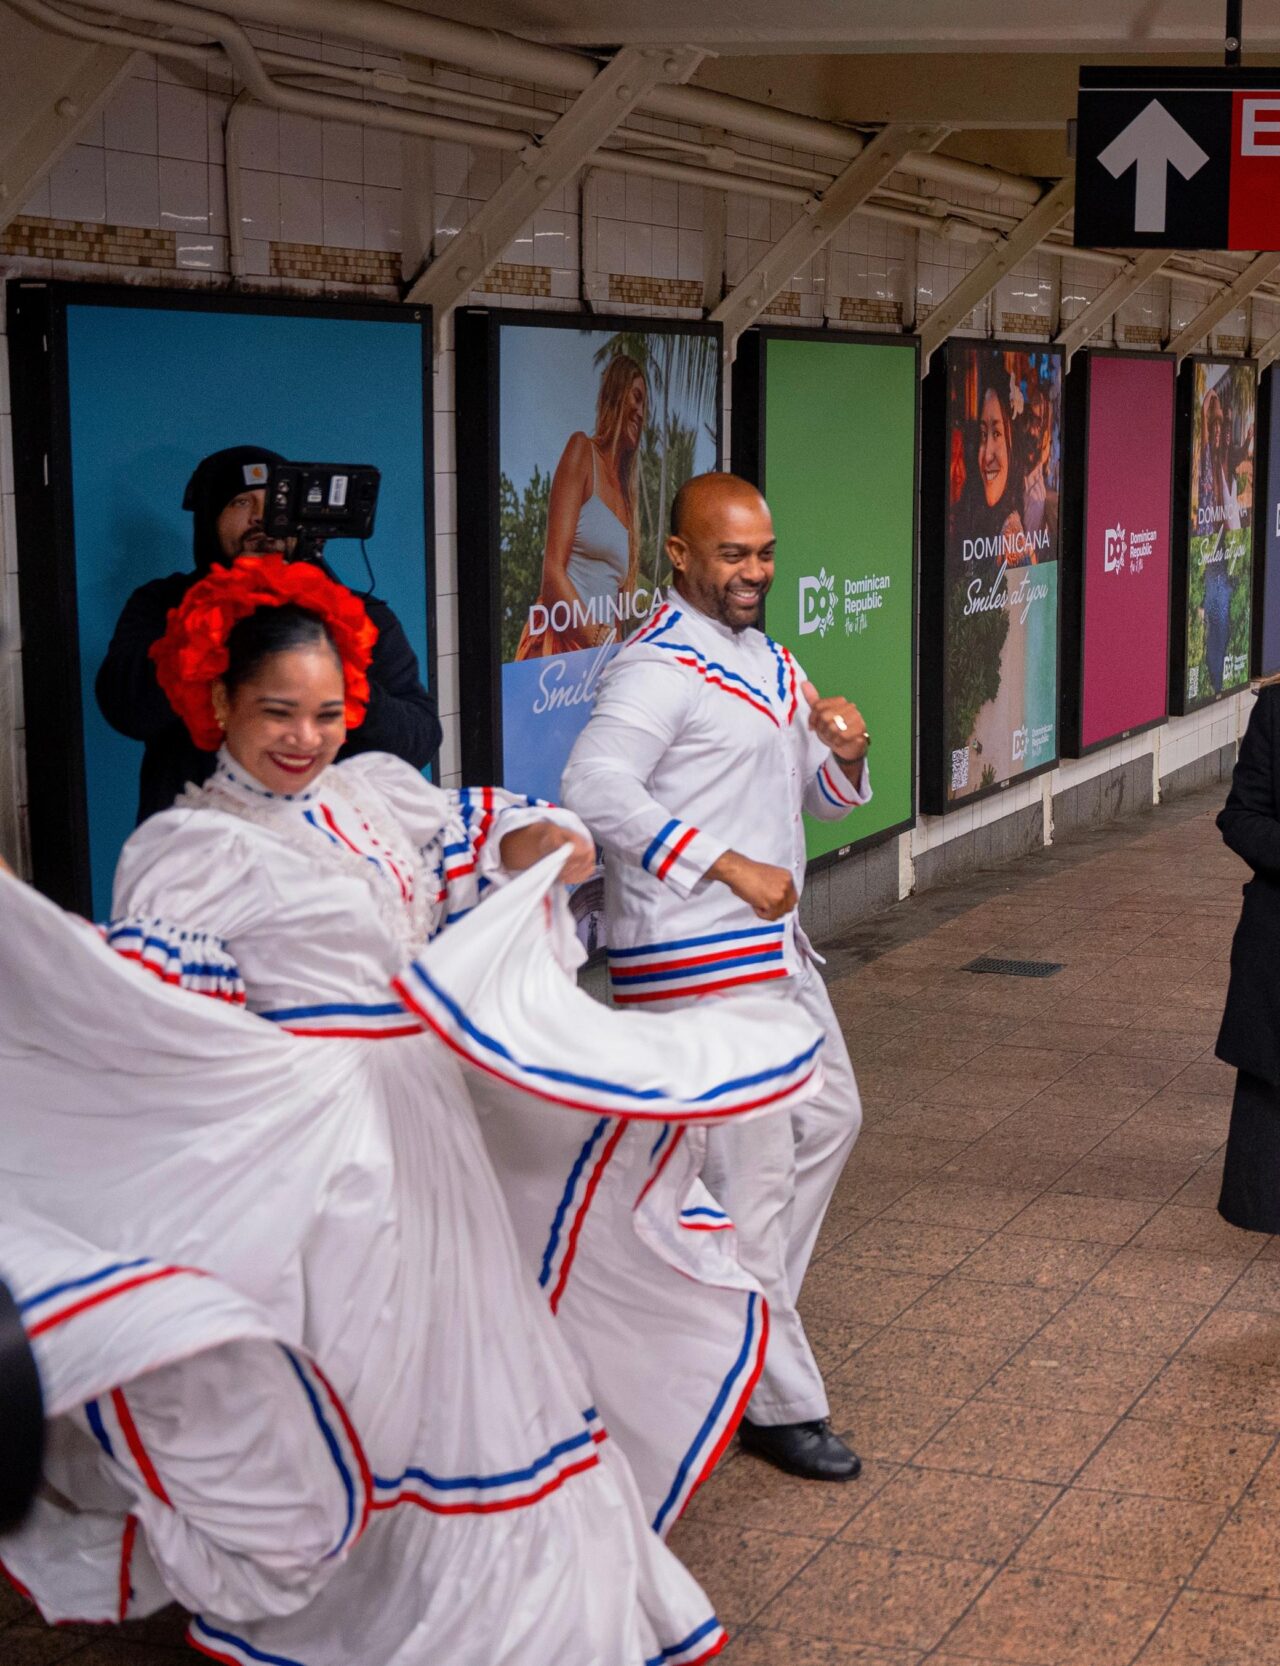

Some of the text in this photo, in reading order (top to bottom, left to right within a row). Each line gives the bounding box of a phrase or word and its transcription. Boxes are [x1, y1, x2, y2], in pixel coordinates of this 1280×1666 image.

[1198, 504, 1248, 525] DOMINICNA
[963, 528, 1051, 561] DOMINICANA
[1130, 529, 1157, 545] Dominican
[1130, 542, 1153, 560] Republic
[844, 573, 890, 596] Dominican
[963, 559, 1049, 625] Smiles at you
[528, 584, 672, 636] DOMINICA
[844, 592, 883, 616] Republic
[532, 626, 617, 714] Smil
